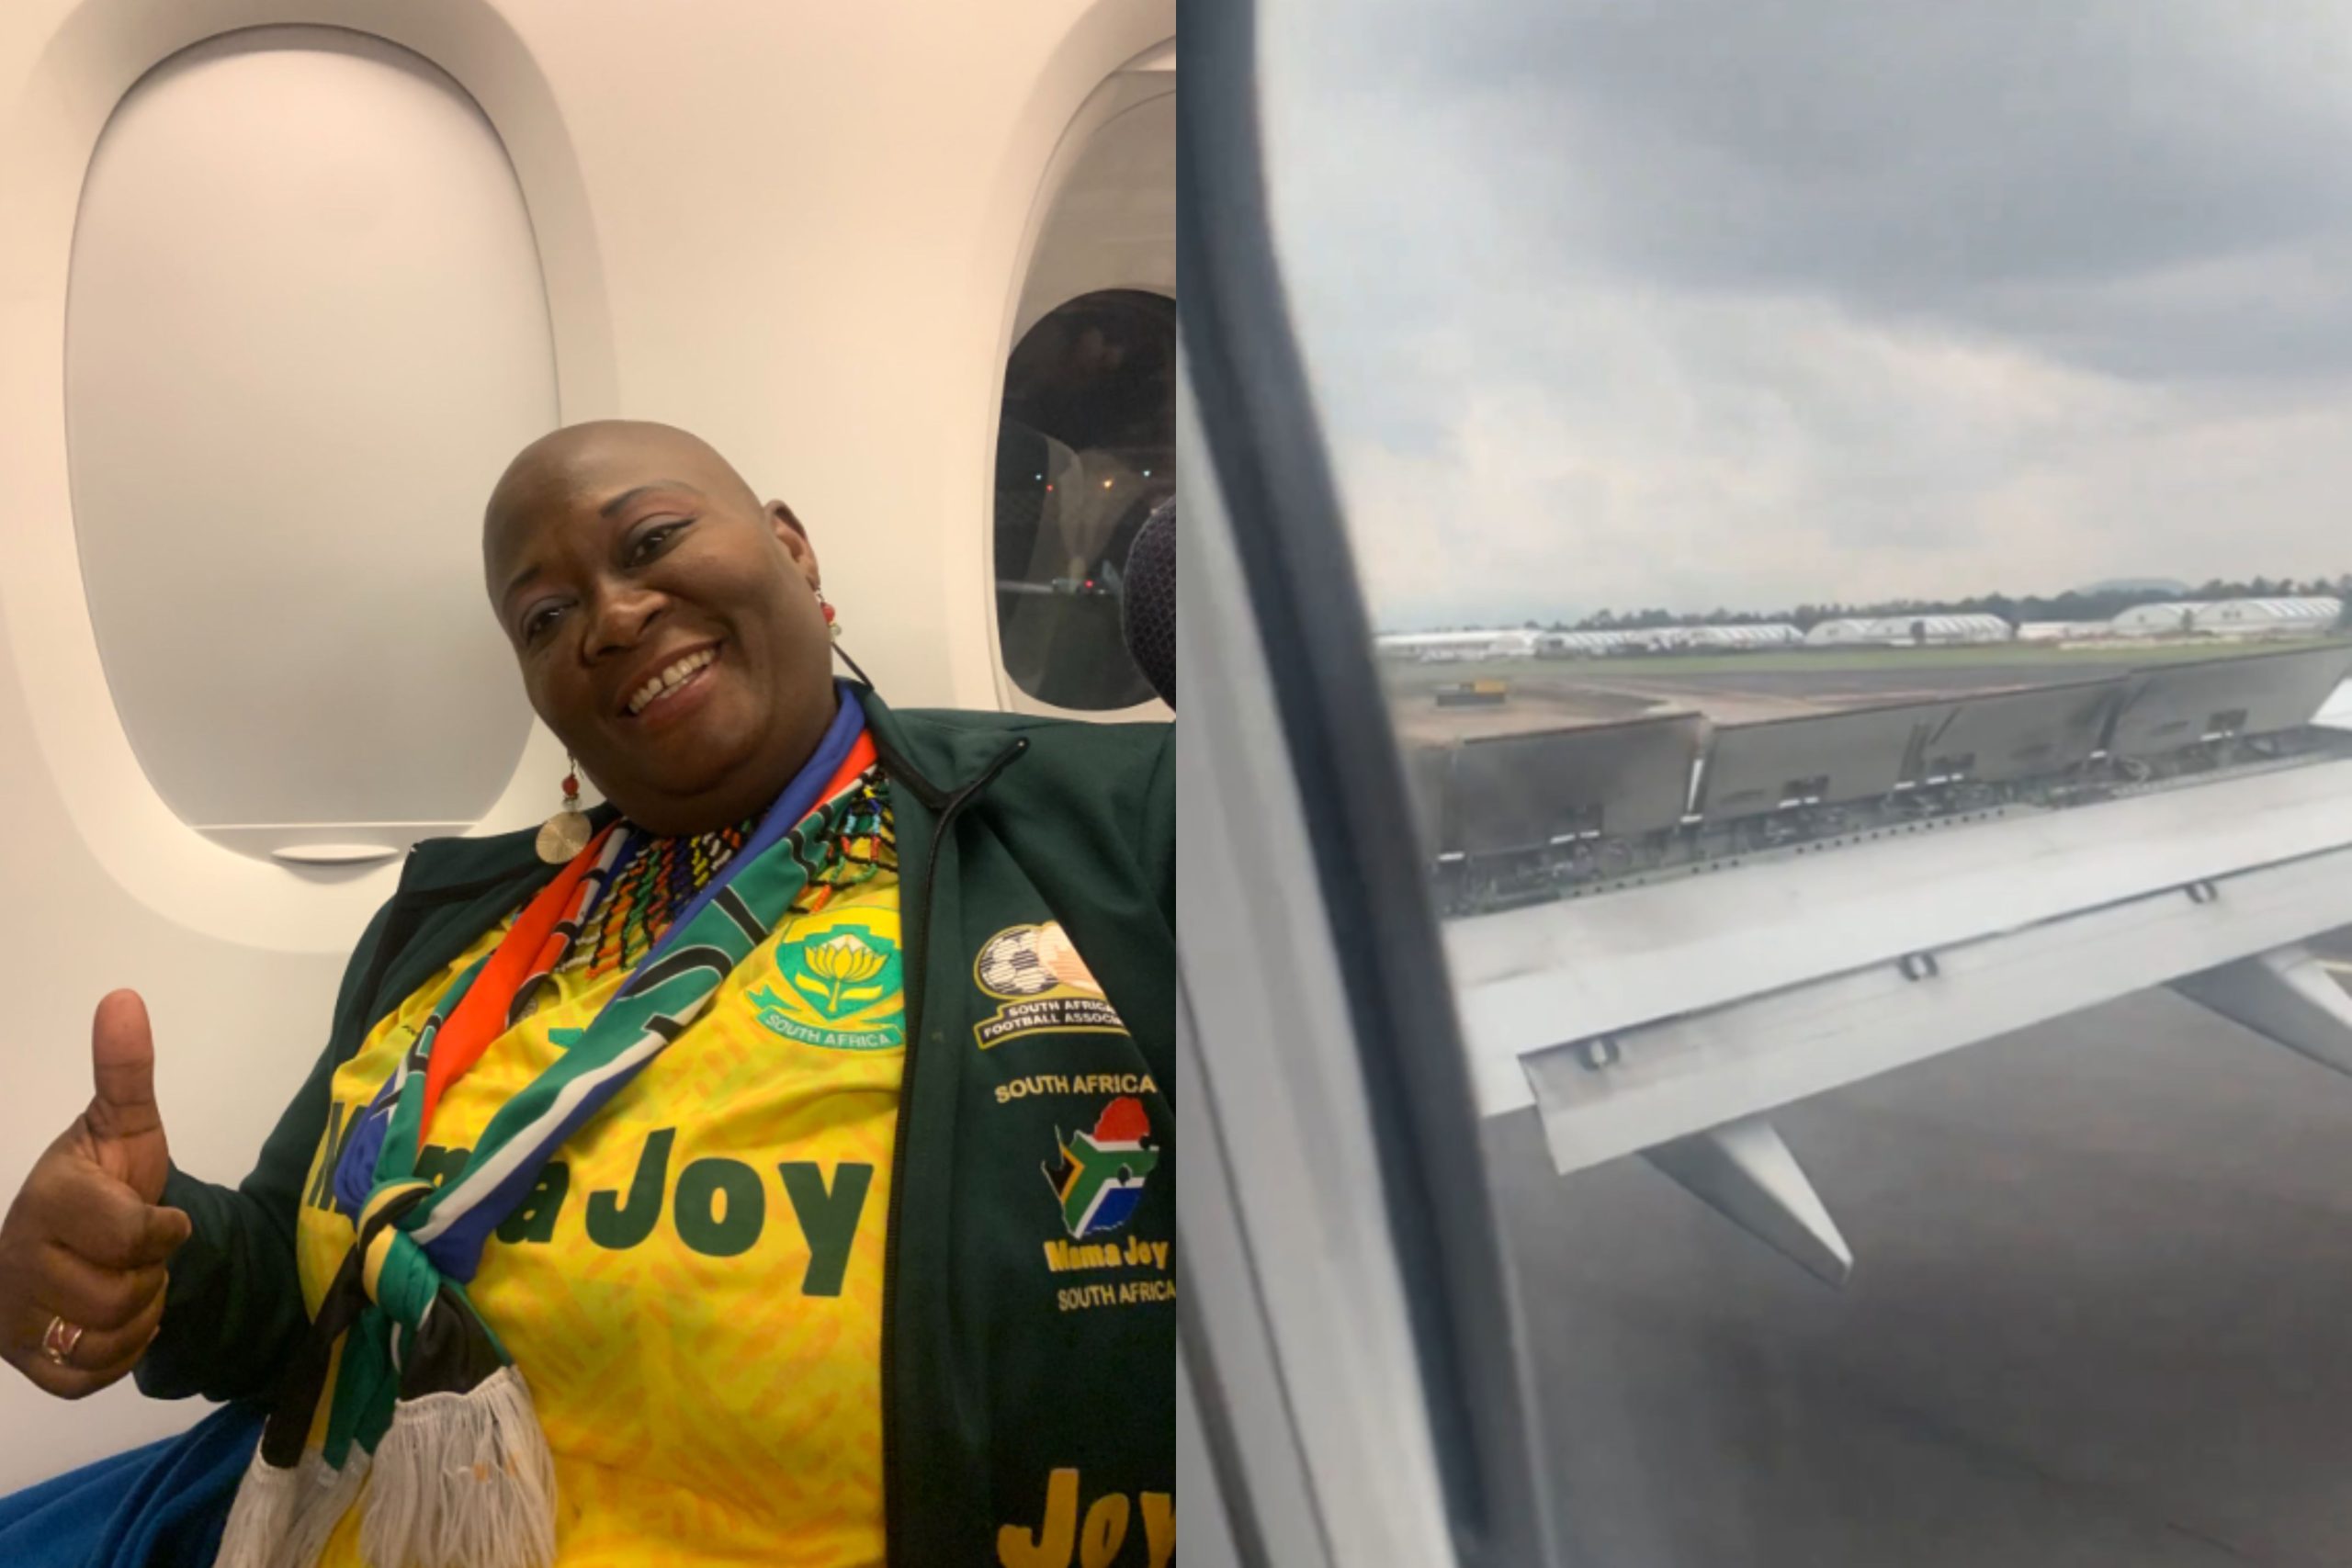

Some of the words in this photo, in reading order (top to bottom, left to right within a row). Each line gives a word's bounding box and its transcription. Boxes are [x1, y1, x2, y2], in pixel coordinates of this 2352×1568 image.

[1008, 1000, 1060, 1017] SOUTH
[765, 1013, 820, 1043] SOUTH
[823, 1032, 891, 1047] AFRICA
[983, 1013, 1060, 1038] FOOTBALL
[994, 1076, 1069, 1103] SOUTH
[1073, 1074, 1158, 1094] AFRICA
[1044, 1240, 1122, 1271] Mama
[1124, 1235, 1169, 1269] Joy
[1057, 1285, 1116, 1311] SOUTH
[1119, 1280, 1176, 1303] AFRICA
